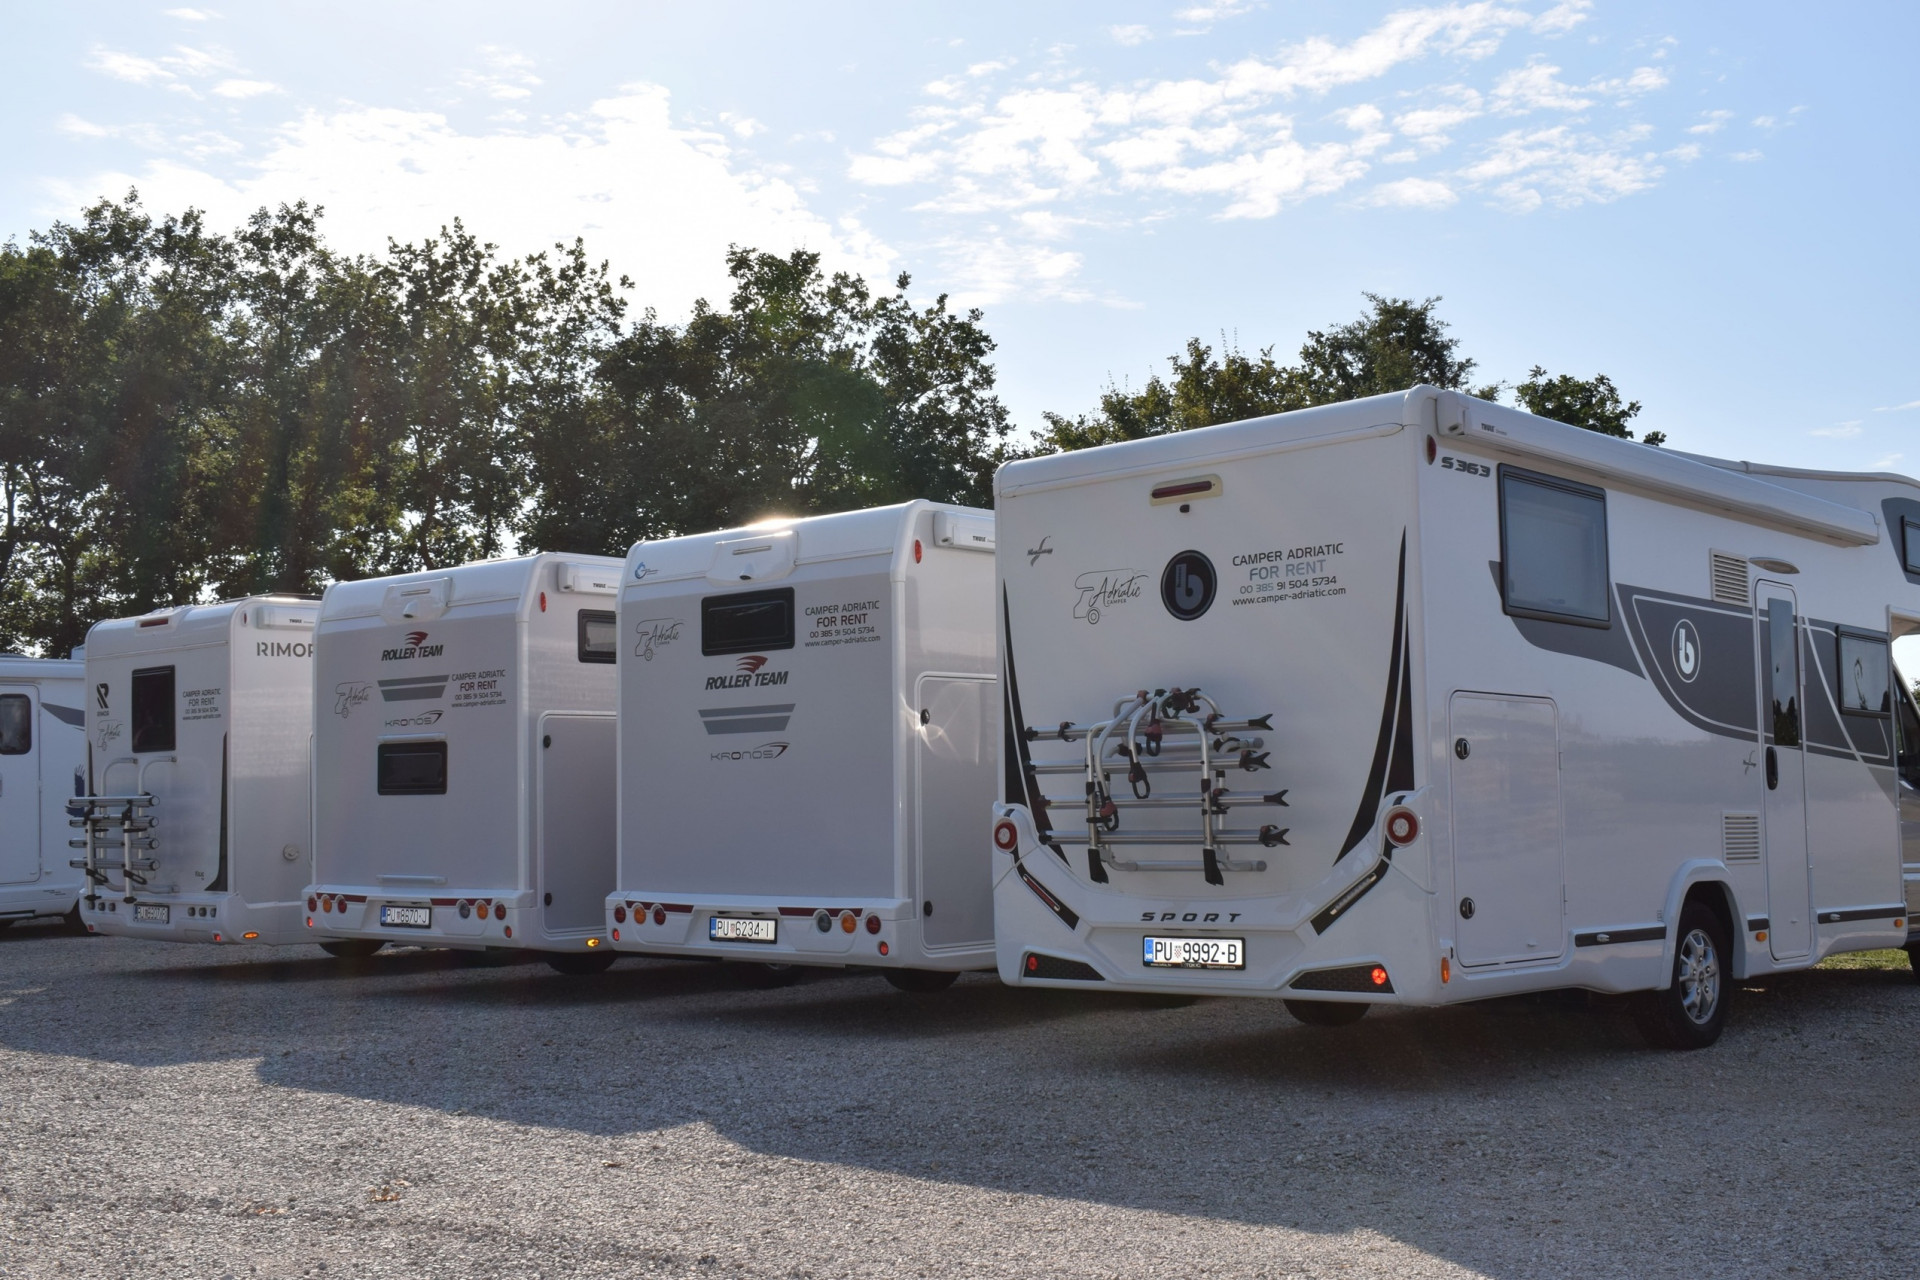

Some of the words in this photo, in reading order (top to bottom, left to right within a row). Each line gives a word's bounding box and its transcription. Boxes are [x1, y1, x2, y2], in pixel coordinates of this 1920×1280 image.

[1232, 551, 1282, 566] CAMPER
[1287, 543, 1344, 560] ADRIATIC
[1250, 566, 1279, 581] FOR
[1286, 560, 1326, 577] RENT
[1089, 575, 1149, 608] Adriatic
[1240, 586, 1253, 594] 00
[1256, 582, 1274, 592] 385
[1276, 582, 1286, 590] 91
[1288, 578, 1309, 590] 504
[1312, 576, 1336, 587] 5734
[1232, 587, 1346, 606] www.camper-adriatic.com
[805, 605, 838, 616] CAMPER
[842, 601, 880, 612] ADRIATIC
[816, 616, 837, 628] FOR
[841, 614, 868, 626] RENT
[842, 628, 856, 636] 504
[858, 626, 874, 634] 5734
[805, 636, 880, 648] www.camper-adriatic.com
[382, 648, 416, 661] ROLLER
[418, 645, 444, 658] TEAM
[452, 672, 476, 682] CAMPER
[478, 670, 505, 678] ADRIATIC
[705, 674, 751, 690] ROLLER
[754, 671, 788, 686] TEAM
[460, 682, 474, 691] FOR
[478, 680, 497, 690] RENT
[1141, 912, 1242, 922] SPORT
[718, 921, 729, 936] PU
[1155, 942, 1172, 960] PU
[1183, 942, 1237, 963] 9992-B
